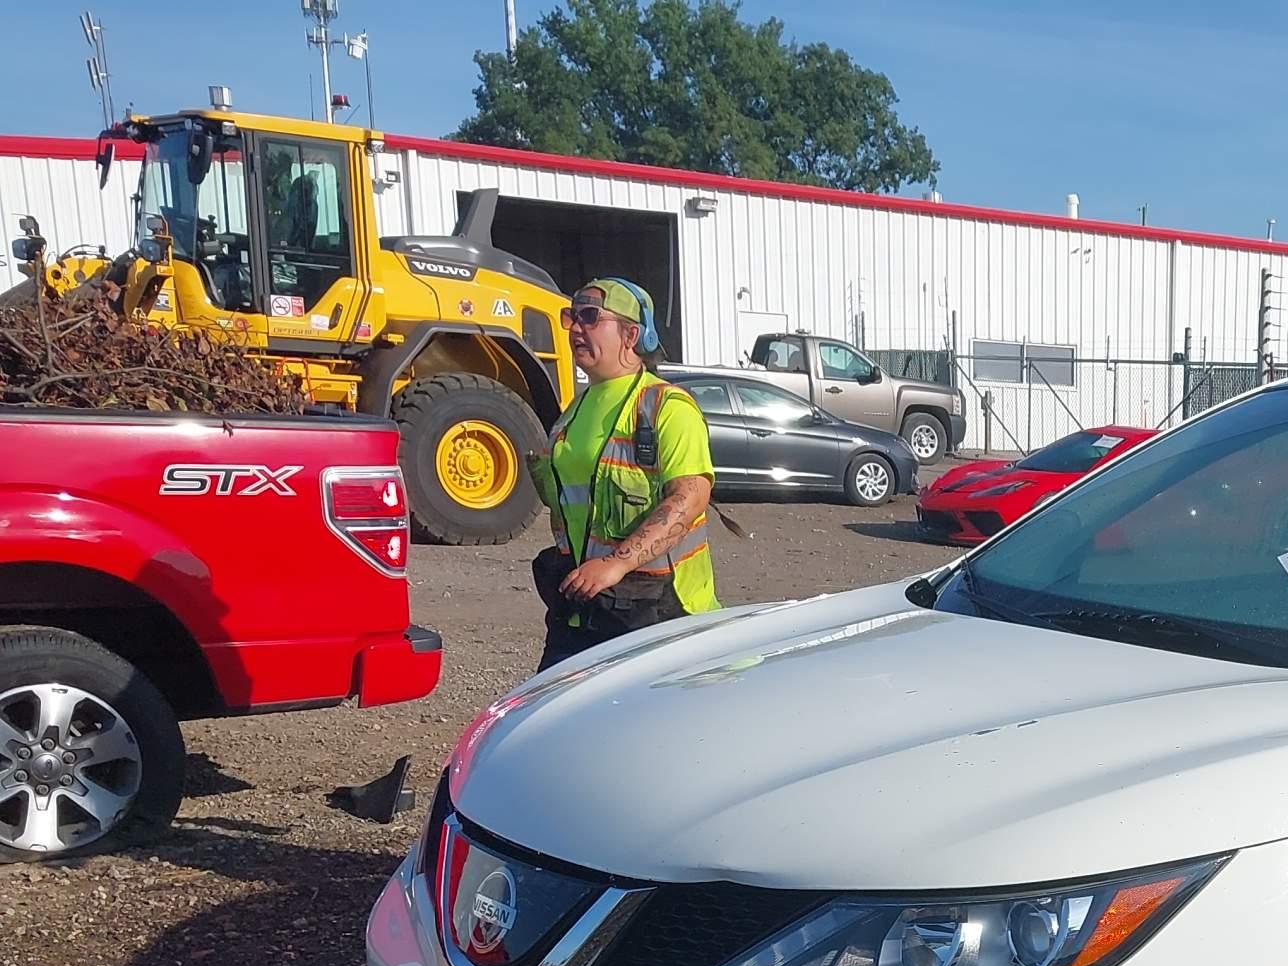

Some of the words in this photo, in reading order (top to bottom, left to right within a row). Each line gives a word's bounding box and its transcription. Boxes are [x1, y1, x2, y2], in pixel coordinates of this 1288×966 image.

[412, 260, 471, 277] VOLVO
[158, 463, 304, 496] STX
[473, 896, 510, 924] NISSAN
